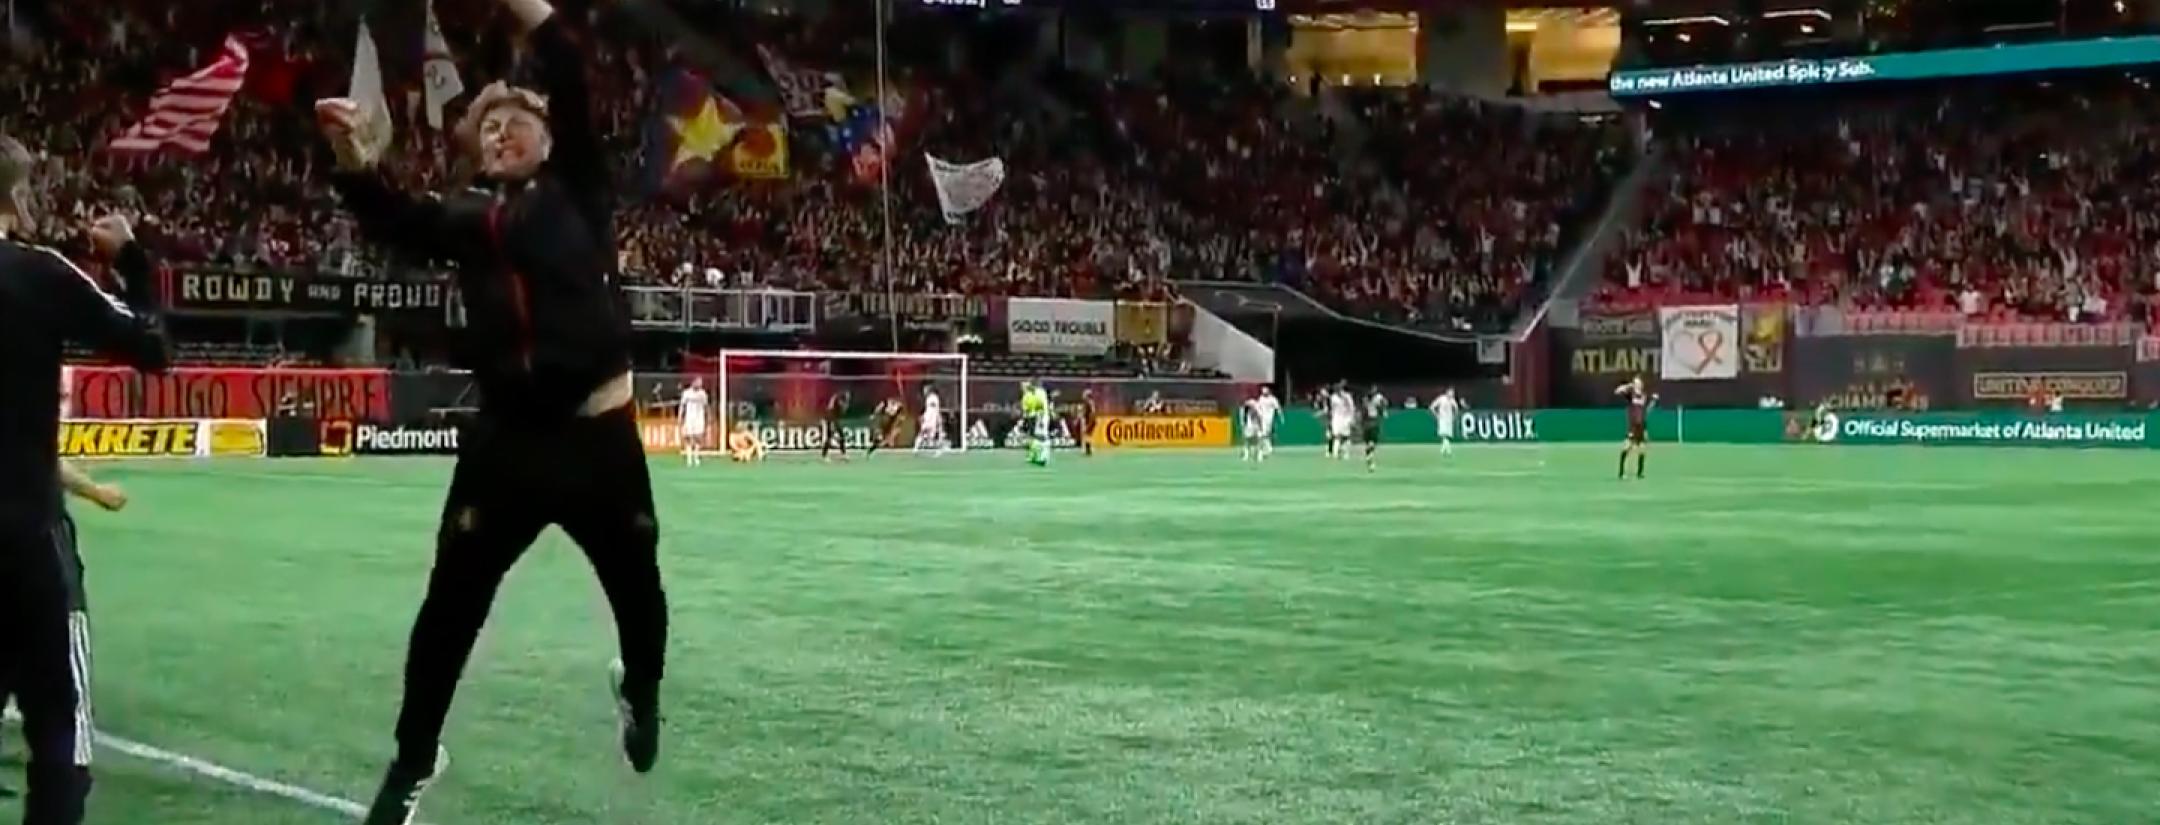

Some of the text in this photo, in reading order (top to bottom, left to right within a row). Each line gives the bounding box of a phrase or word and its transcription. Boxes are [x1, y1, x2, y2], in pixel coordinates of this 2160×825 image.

[1611, 77, 1634, 91] the
[1637, 77, 1669, 89] new
[1672, 69, 1728, 87] Atlanta
[1731, 66, 1785, 84] United
[183, 275, 294, 303] ROWDY
[353, 283, 440, 308] PROUD
[1012, 319, 1105, 336] GOOD TROUBLE
[1572, 348, 1661, 374] ATLANT
[356, 424, 458, 450] Piedmont
[1106, 418, 1195, 446] Continental
[1461, 411, 1536, 440] Publix
[1844, 418, 2146, 442] Official Supermarket of Atlanta United
